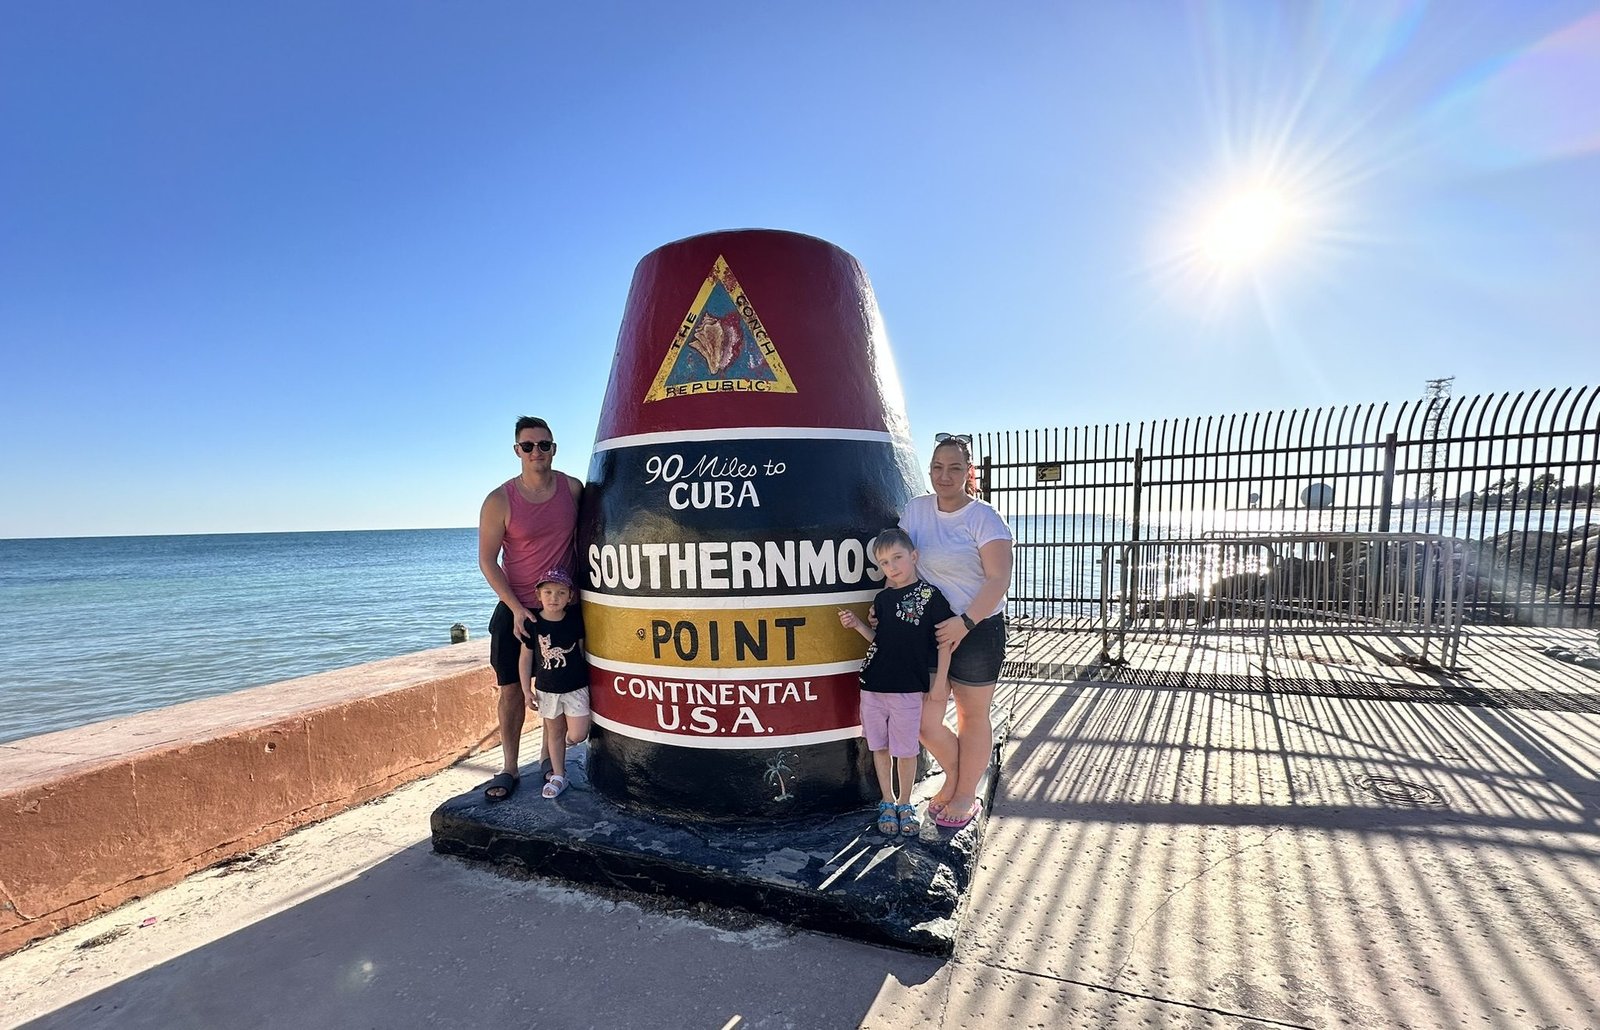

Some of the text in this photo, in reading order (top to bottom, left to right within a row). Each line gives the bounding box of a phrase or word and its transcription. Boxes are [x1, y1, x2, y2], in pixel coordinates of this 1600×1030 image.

[671, 312, 697, 351] THE
[735, 292, 776, 356] CONCH
[665, 380, 767, 397] REPUBLIC
[645, 453, 787, 485] 90 Miles to
[668, 480, 761, 510] CUBA
[588, 537, 887, 590] SOUTHERNMOS
[651, 616, 807, 662] POINT
[613, 676, 818, 706] CONTINENTAL
[655, 703, 774, 734] U.S.A.
